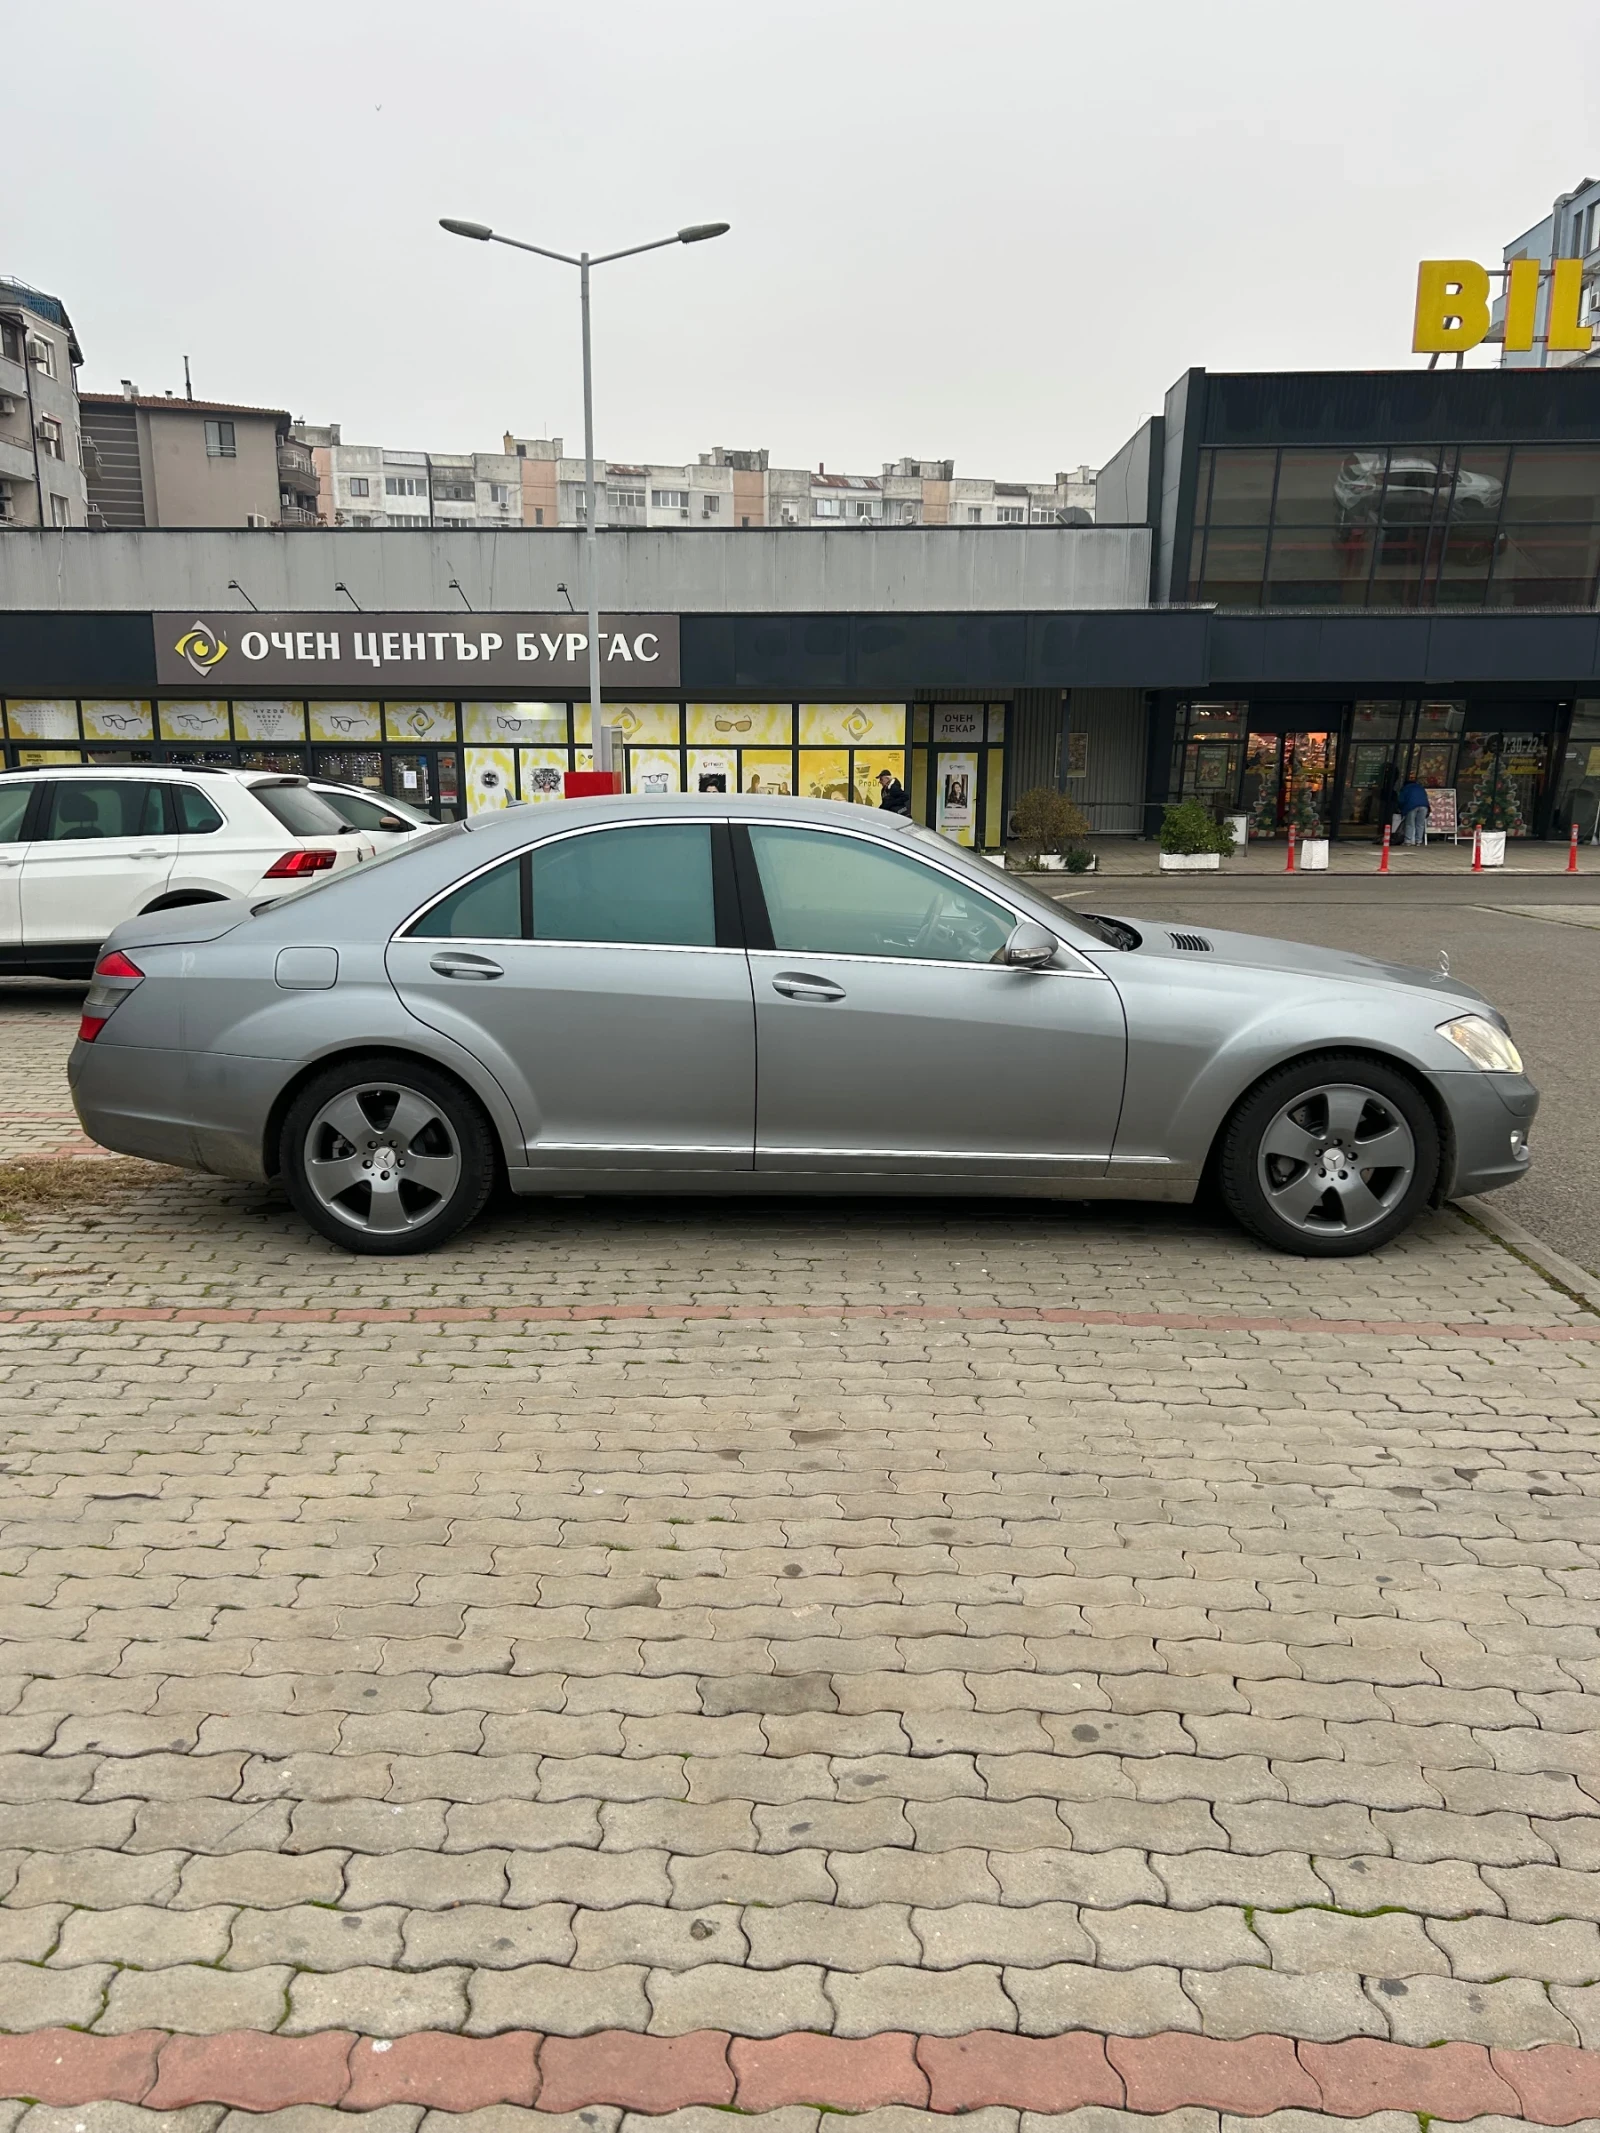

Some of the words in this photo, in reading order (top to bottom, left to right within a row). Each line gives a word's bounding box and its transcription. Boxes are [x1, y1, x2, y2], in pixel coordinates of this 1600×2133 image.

[1411, 258, 1593, 353] BIL
[241, 631, 341, 660] ОЧЕН
[353, 632, 503, 667] ЦЕНТЪР
[941, 724, 976, 733] ЛЕКАР
[944, 714, 973, 722] ОЧЕН
